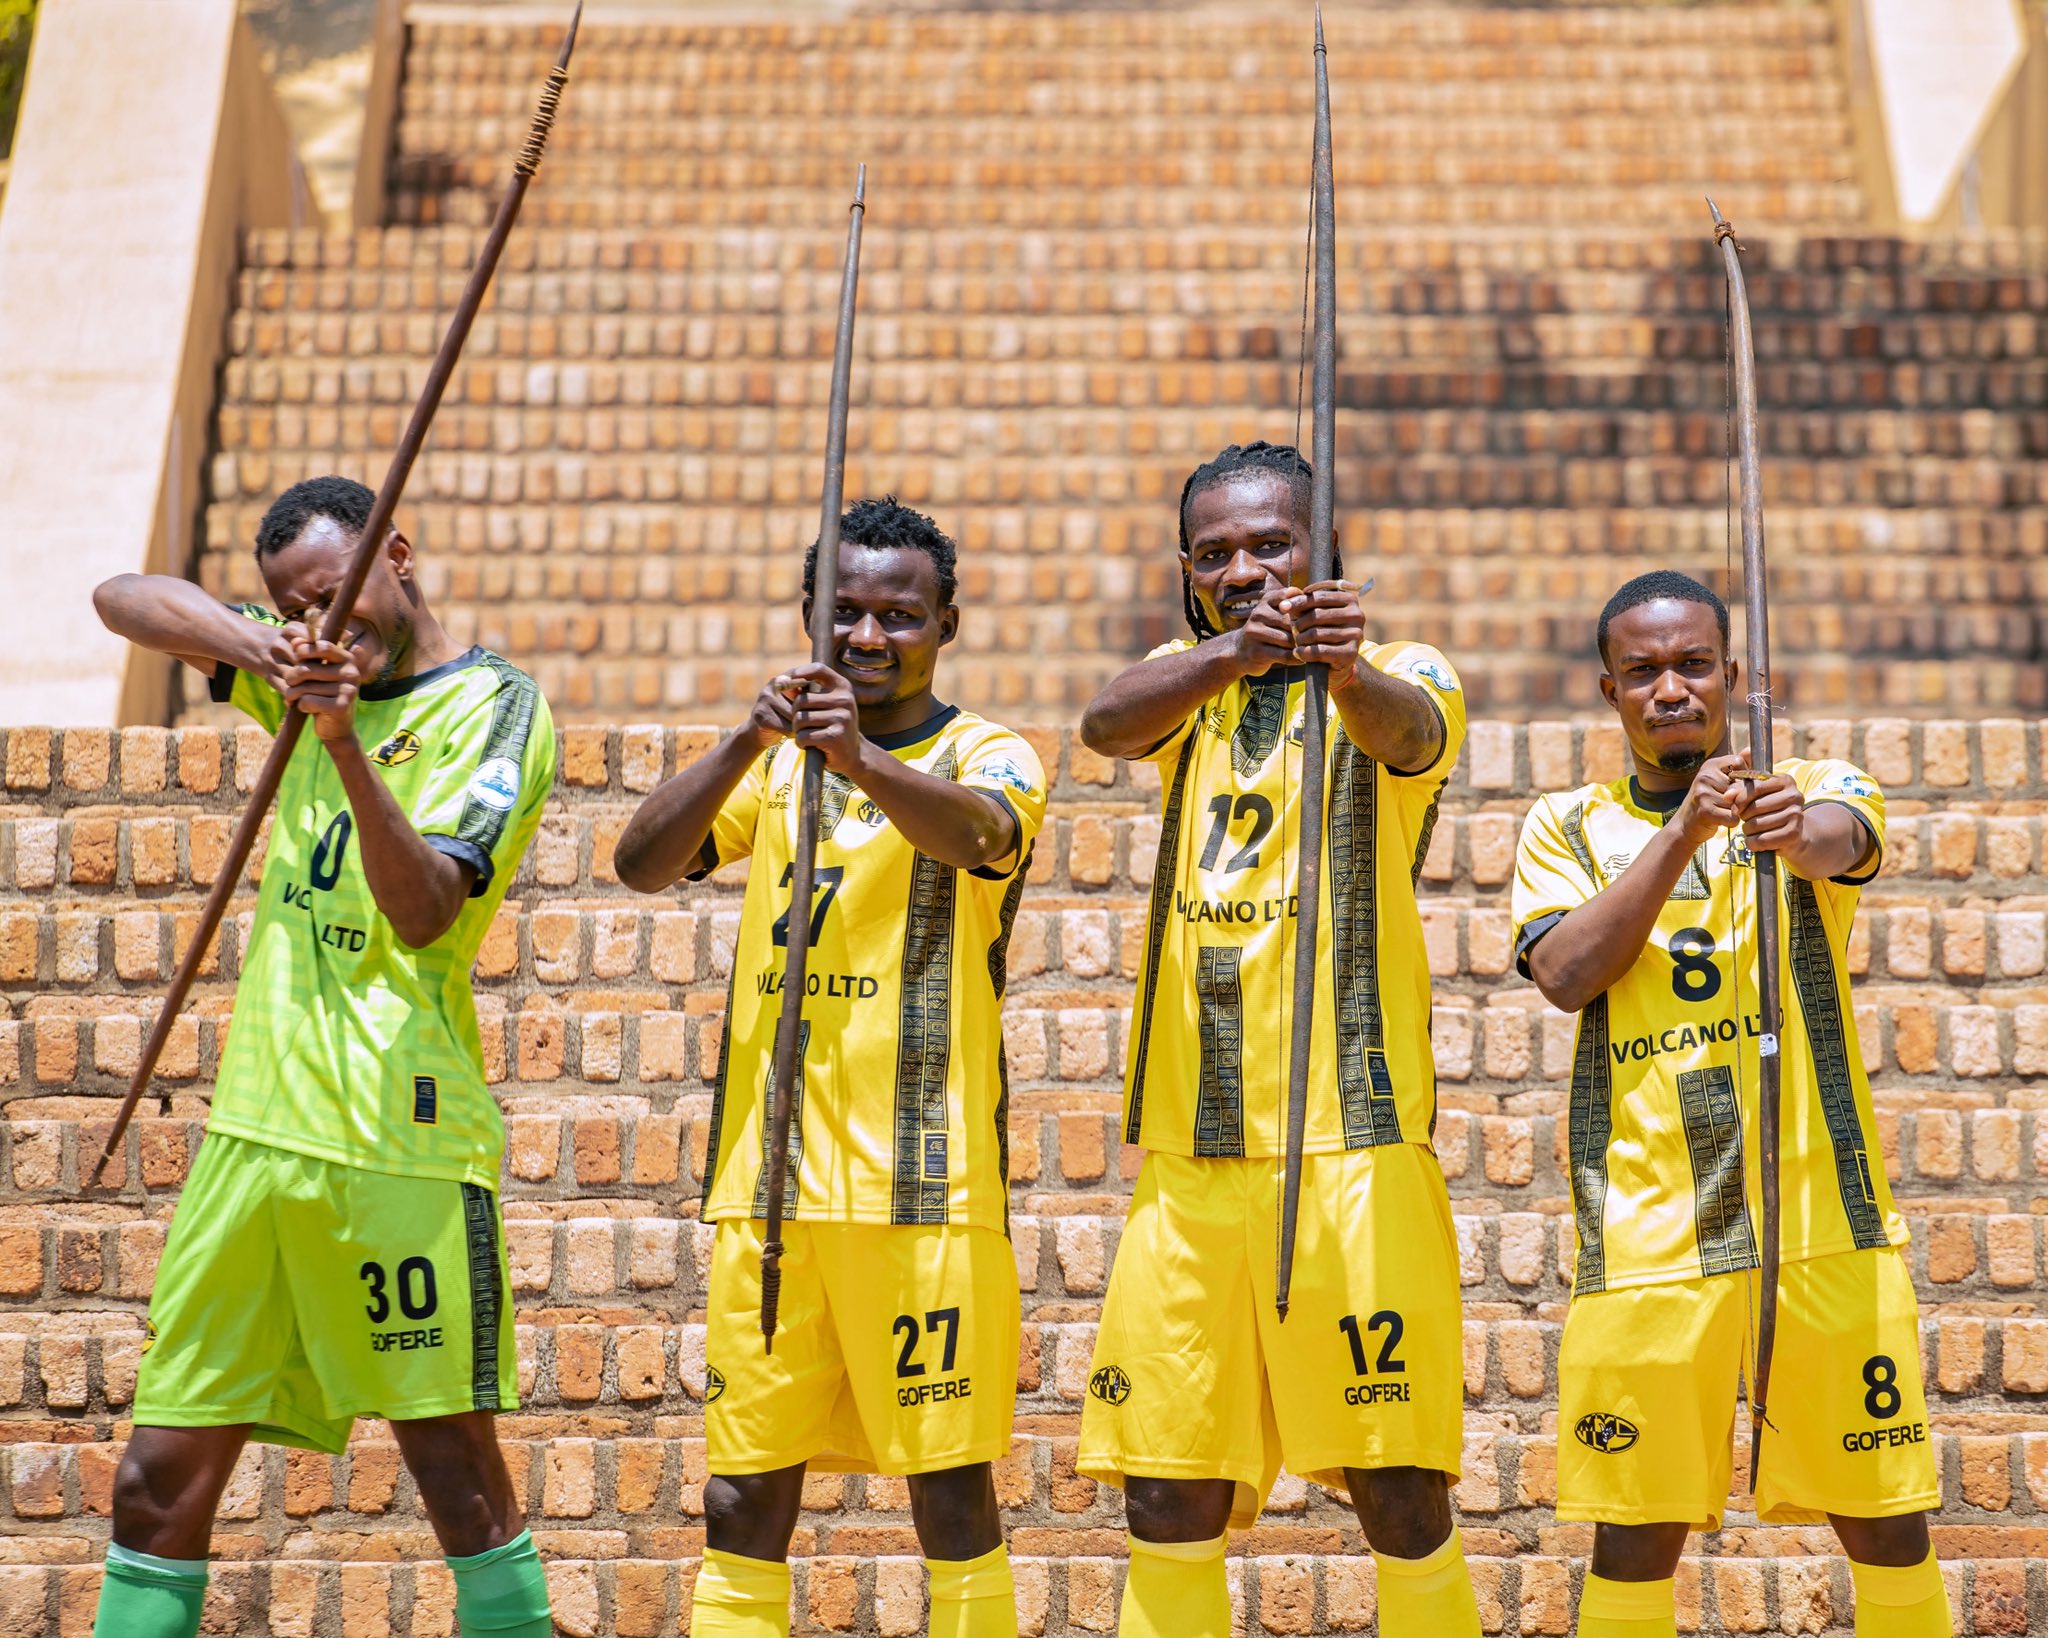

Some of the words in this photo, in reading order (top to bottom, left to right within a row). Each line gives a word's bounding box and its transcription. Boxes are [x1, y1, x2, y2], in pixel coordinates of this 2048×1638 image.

[1198, 793, 1274, 874] 12
[771, 861, 845, 948] 27
[321, 923, 367, 953] LTD
[1668, 926, 1722, 1003] 8
[827, 973, 879, 999] LTD
[1611, 1017, 1738, 1065] VOLCANO
[360, 1255, 438, 1325] 30
[892, 1306, 961, 1379] 27
[1338, 1310, 1406, 1377] 12
[896, 1377, 972, 1408] GOFERE
[1344, 1382, 1411, 1406] GOFERE
[1862, 1354, 1902, 1420] 8
[1842, 1422, 1926, 1453] GOFERE
